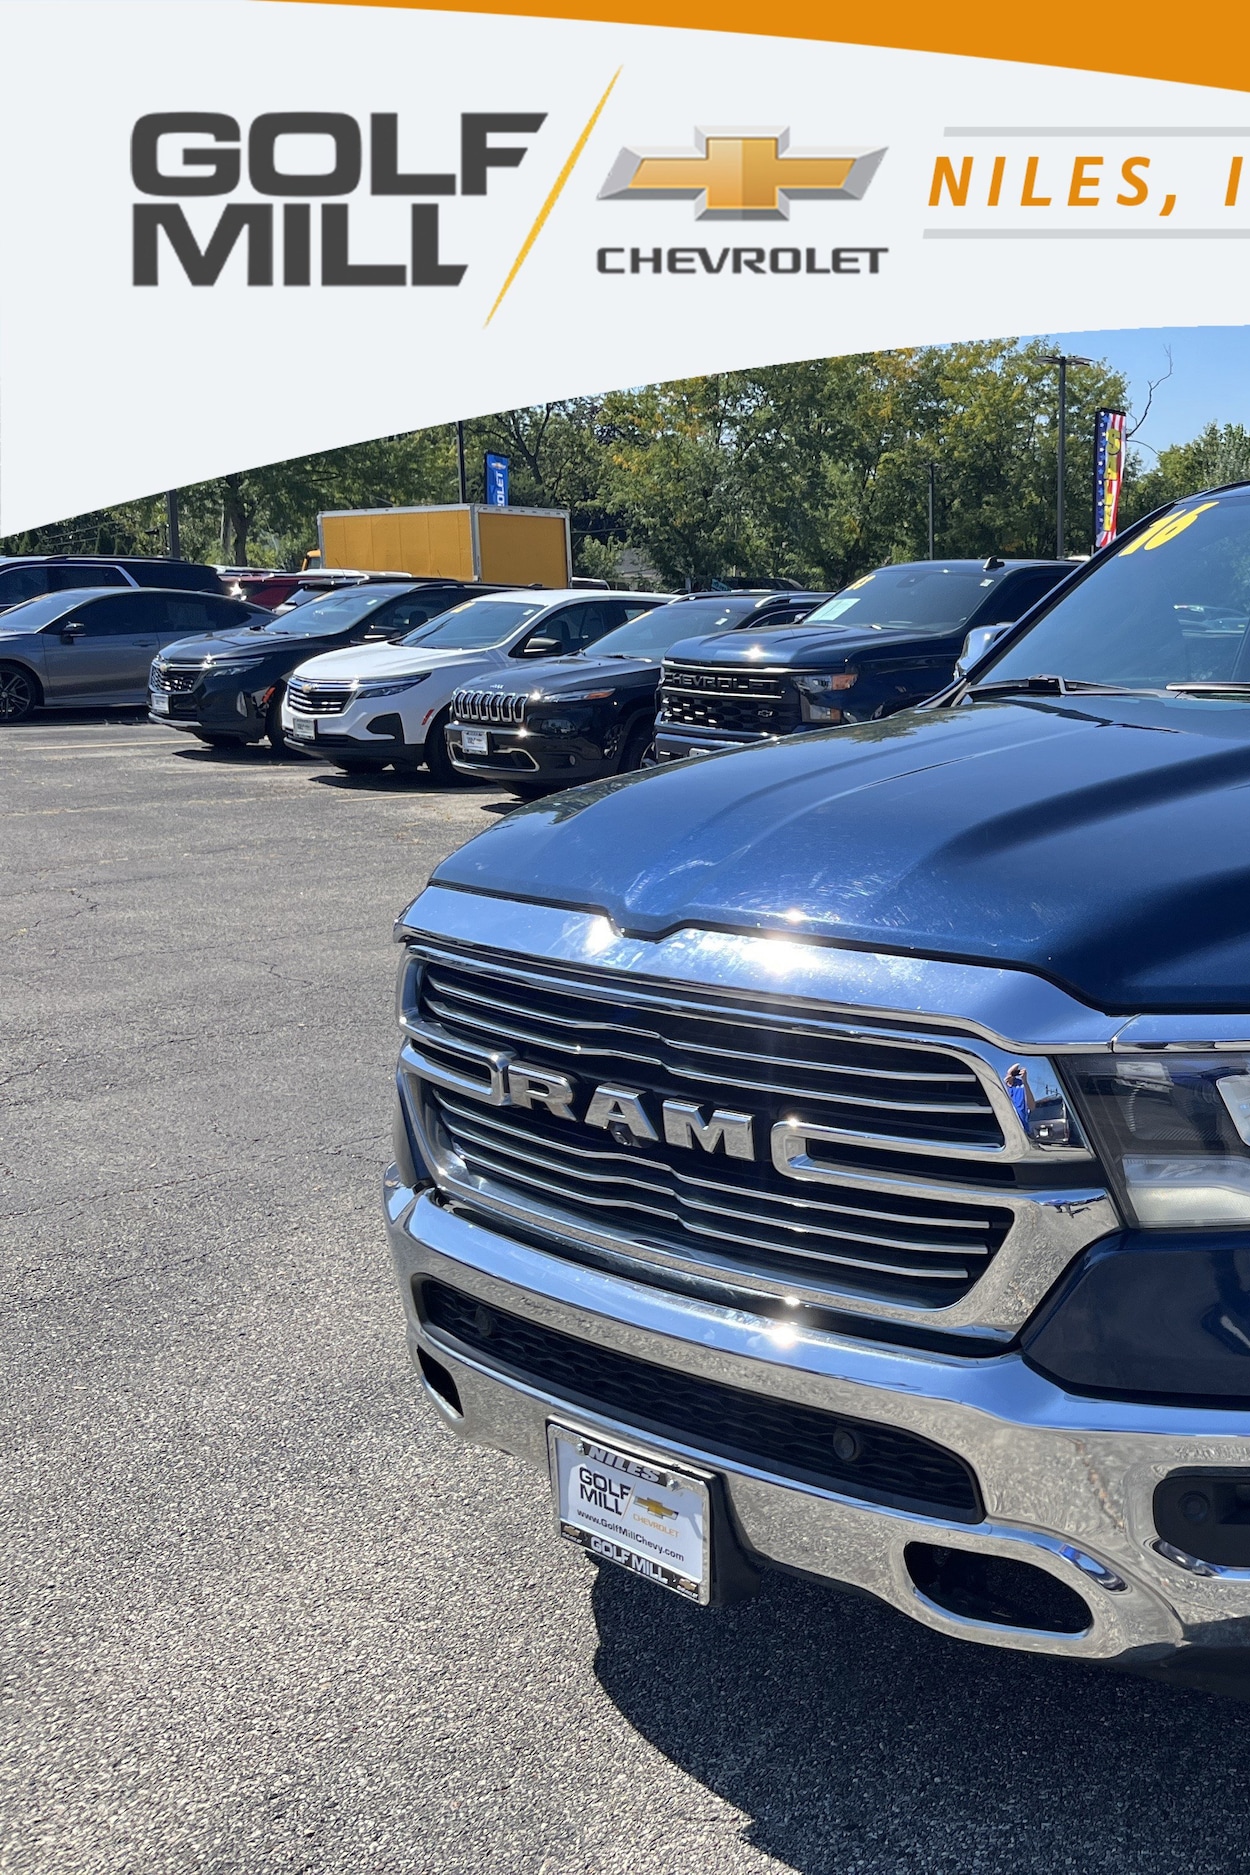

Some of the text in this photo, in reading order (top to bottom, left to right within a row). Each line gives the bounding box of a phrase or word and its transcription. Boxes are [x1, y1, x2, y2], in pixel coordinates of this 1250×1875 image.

[506, 1058, 755, 1161] RAM
[587, 1446, 661, 1483] NILES
[579, 1467, 631, 1500] GOLF
[580, 1485, 623, 1516] MILL
[577, 1509, 685, 1562] www.GolfMillChevy.com
[634, 1515, 680, 1538] CHEVROLET
[590, 1536, 629, 1563] GOLF
[632, 1555, 669, 1584] MILL
